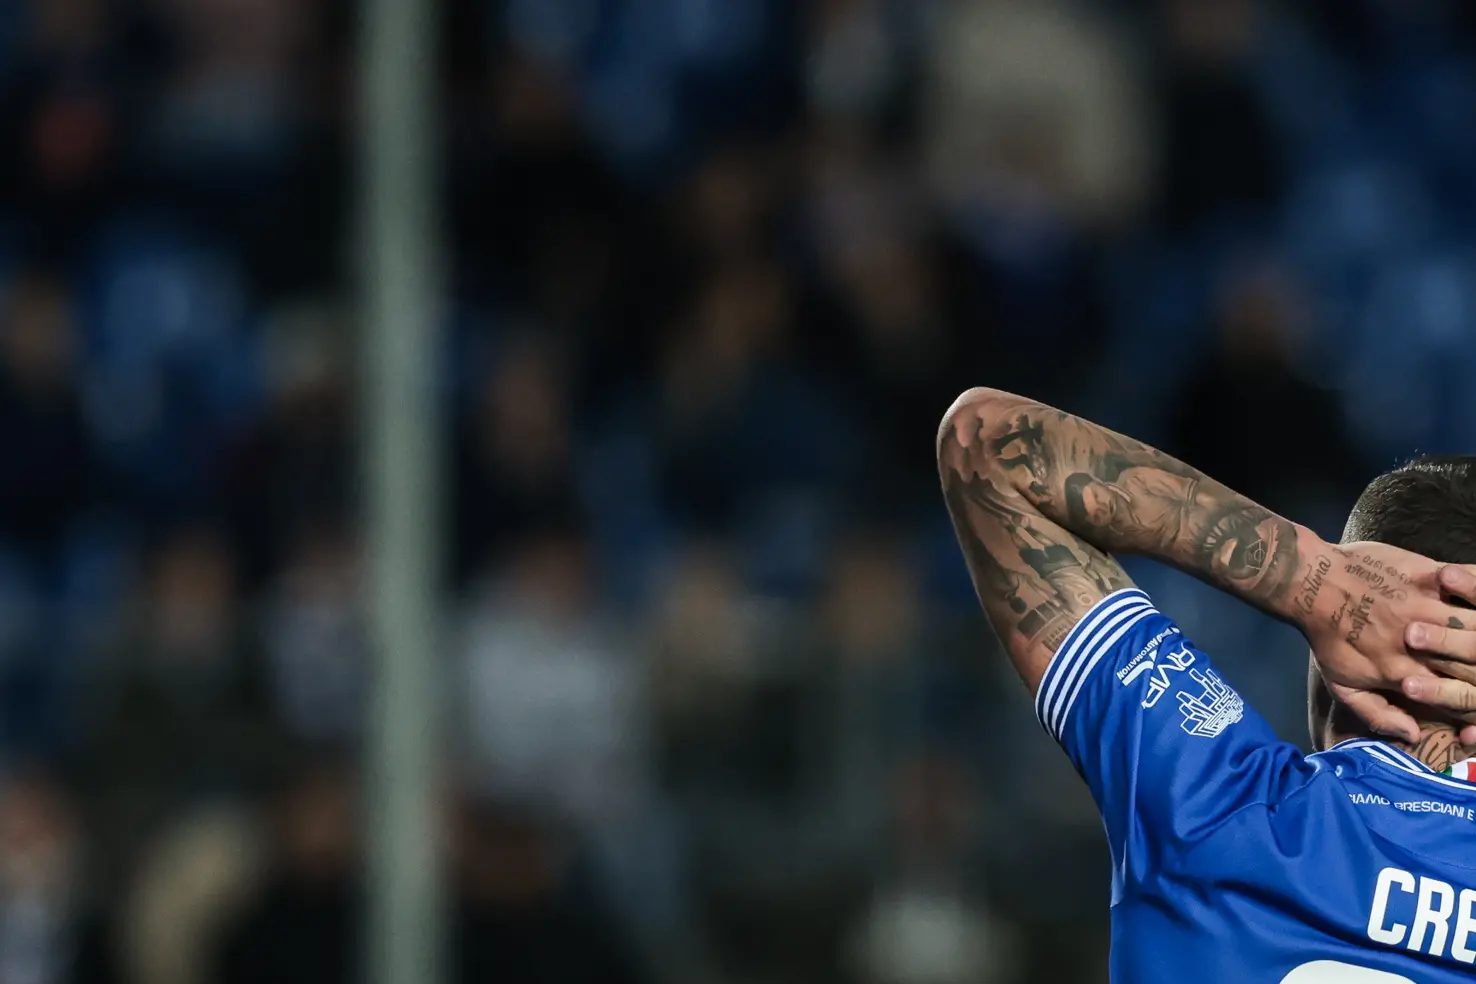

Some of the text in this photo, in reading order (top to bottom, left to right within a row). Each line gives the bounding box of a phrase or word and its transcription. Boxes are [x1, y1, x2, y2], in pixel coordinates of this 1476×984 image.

[1117, 637, 1159, 680] AUTOMATION
[1348, 793, 1391, 806] IAMO
[1393, 801, 1465, 818] BRESCIANI
[1467, 809, 1475, 821] E
